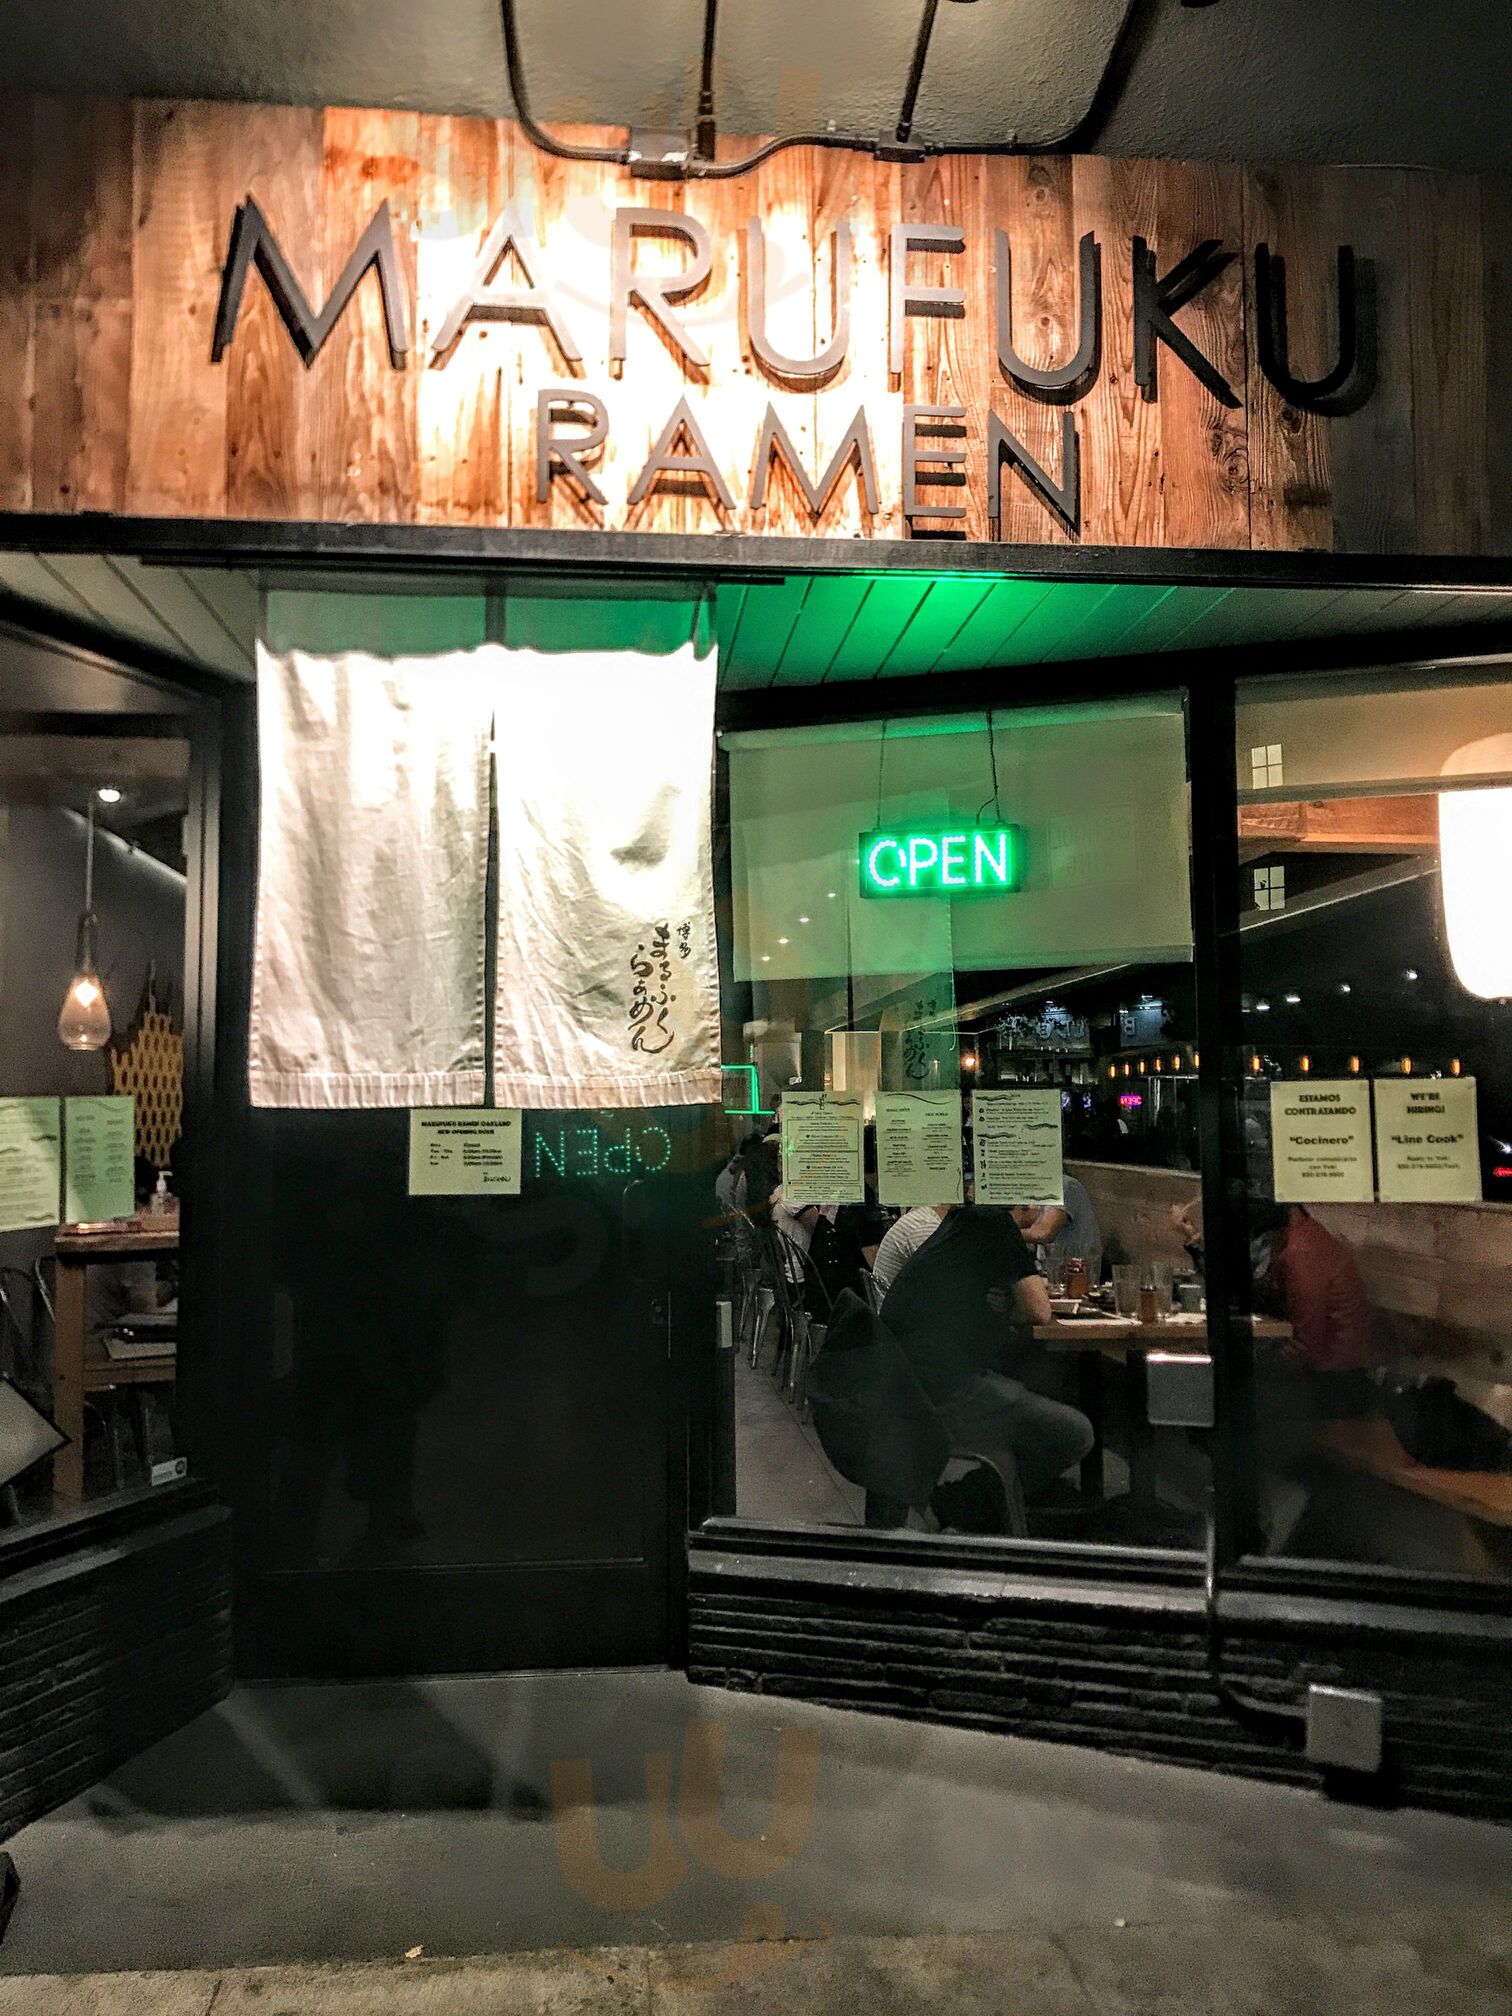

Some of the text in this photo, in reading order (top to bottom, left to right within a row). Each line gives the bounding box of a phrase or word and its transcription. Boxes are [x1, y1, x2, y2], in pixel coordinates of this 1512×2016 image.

[211, 192, 1358, 410] MARUFUKU
[536, 388, 1081, 538] RAMEN
[869, 834, 1007, 888] OPEN
[1284, 1107, 1357, 1116] CONTRATANDO
[1299, 1094, 1341, 1103] ESTAMOS
[1406, 1105, 1445, 1114] HIRING!
